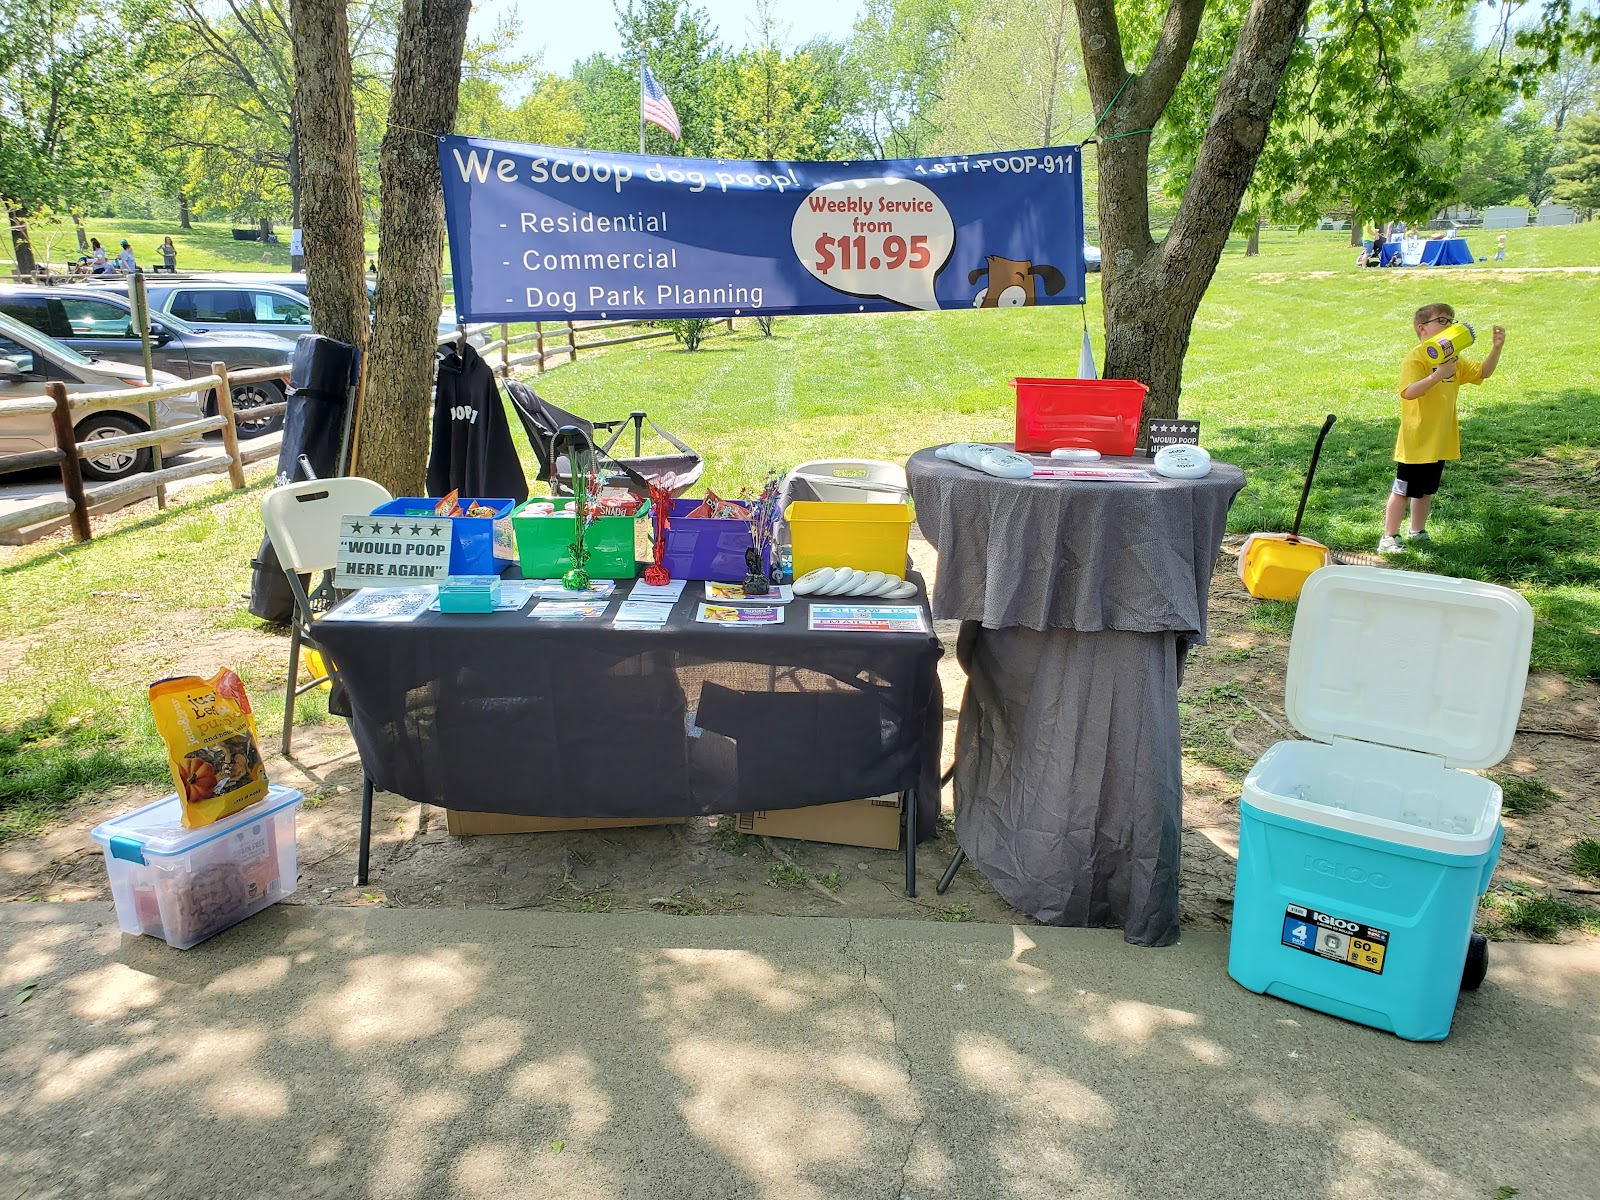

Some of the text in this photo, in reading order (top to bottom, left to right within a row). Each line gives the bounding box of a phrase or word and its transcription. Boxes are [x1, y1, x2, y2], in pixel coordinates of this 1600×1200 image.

[453, 149, 801, 193] We scoop dog poop!
[915, 155, 1073, 175] 1-877-POOP-911
[809, 196, 934, 215] Weekly Service
[521, 212, 668, 233] Residential
[852, 217, 893, 233] from
[523, 249, 677, 271] Commercial
[815, 232, 931, 275] $11.95
[526, 287, 577, 313] Dog
[589, 285, 646, 307] Park
[657, 283, 763, 309] Planning
[1151, 445, 1166, 453] HE
[406, 543, 446, 557] POOP
[346, 562, 384, 576] HERE
[203, 734, 218, 743] and
[1313, 911, 1360, 932] IGLOO
[1292, 925, 1307, 941] 4
[1353, 940, 1371, 952] 60
